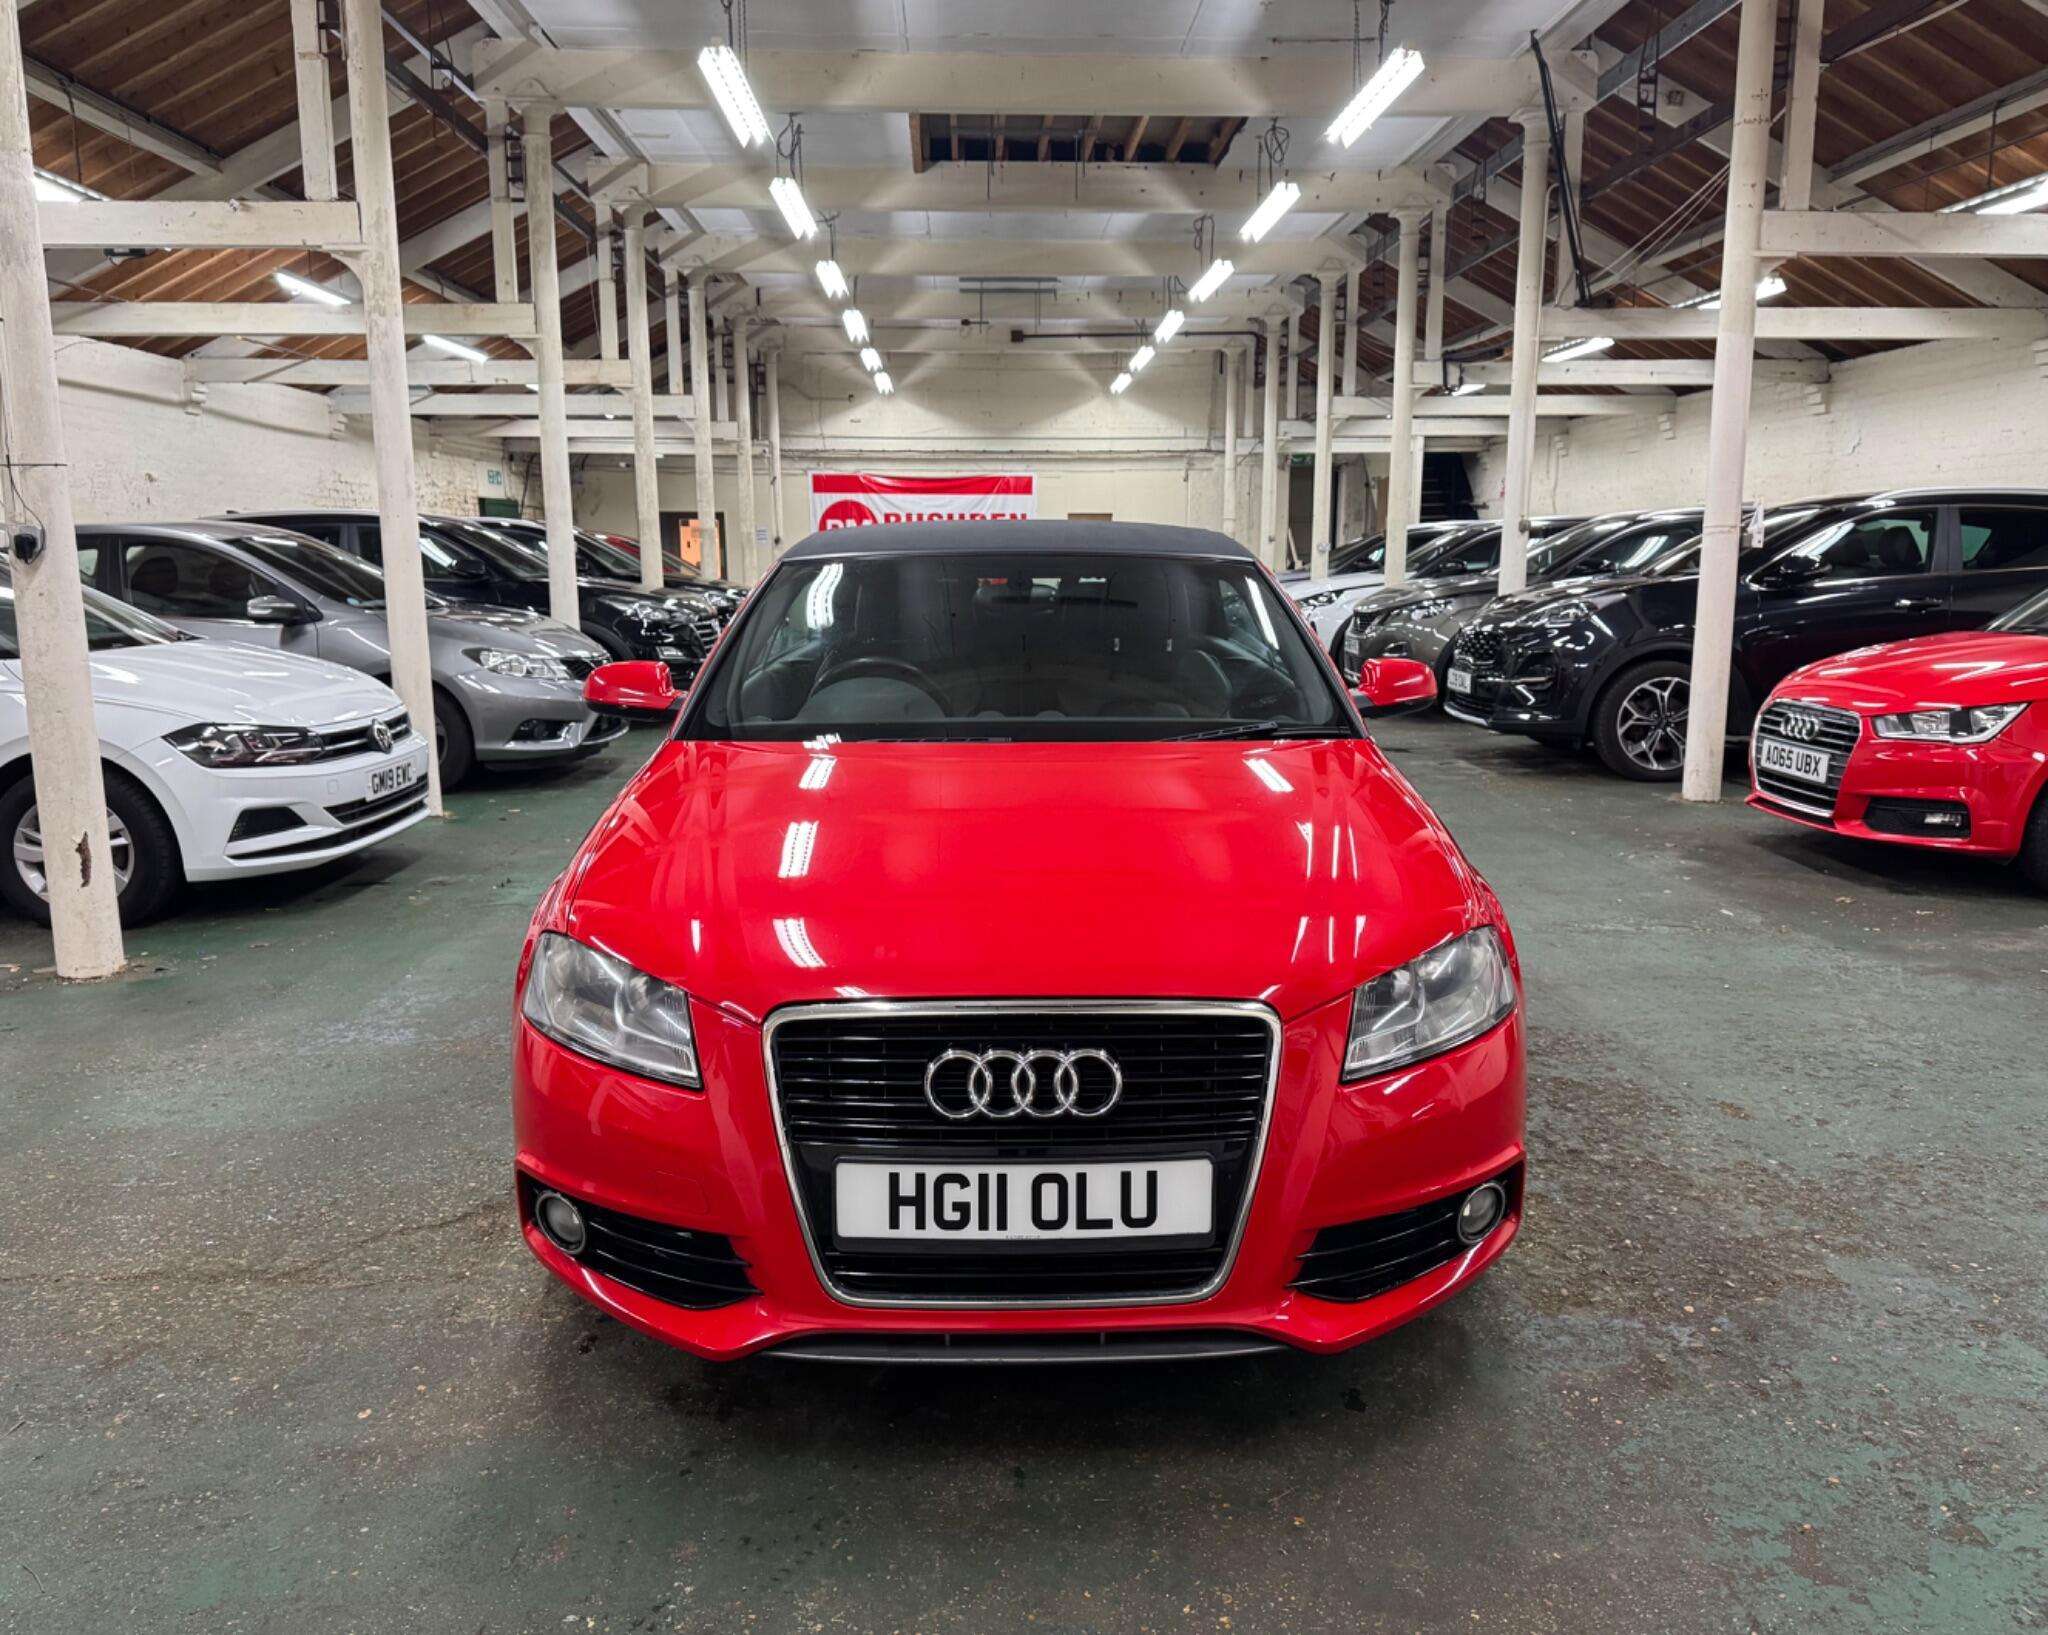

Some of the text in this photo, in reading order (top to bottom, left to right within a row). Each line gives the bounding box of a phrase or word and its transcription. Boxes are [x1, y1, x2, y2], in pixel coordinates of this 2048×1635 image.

[1796, 751, 1821, 777] UBX
[888, 1170, 1158, 1232] HG11 OLU
